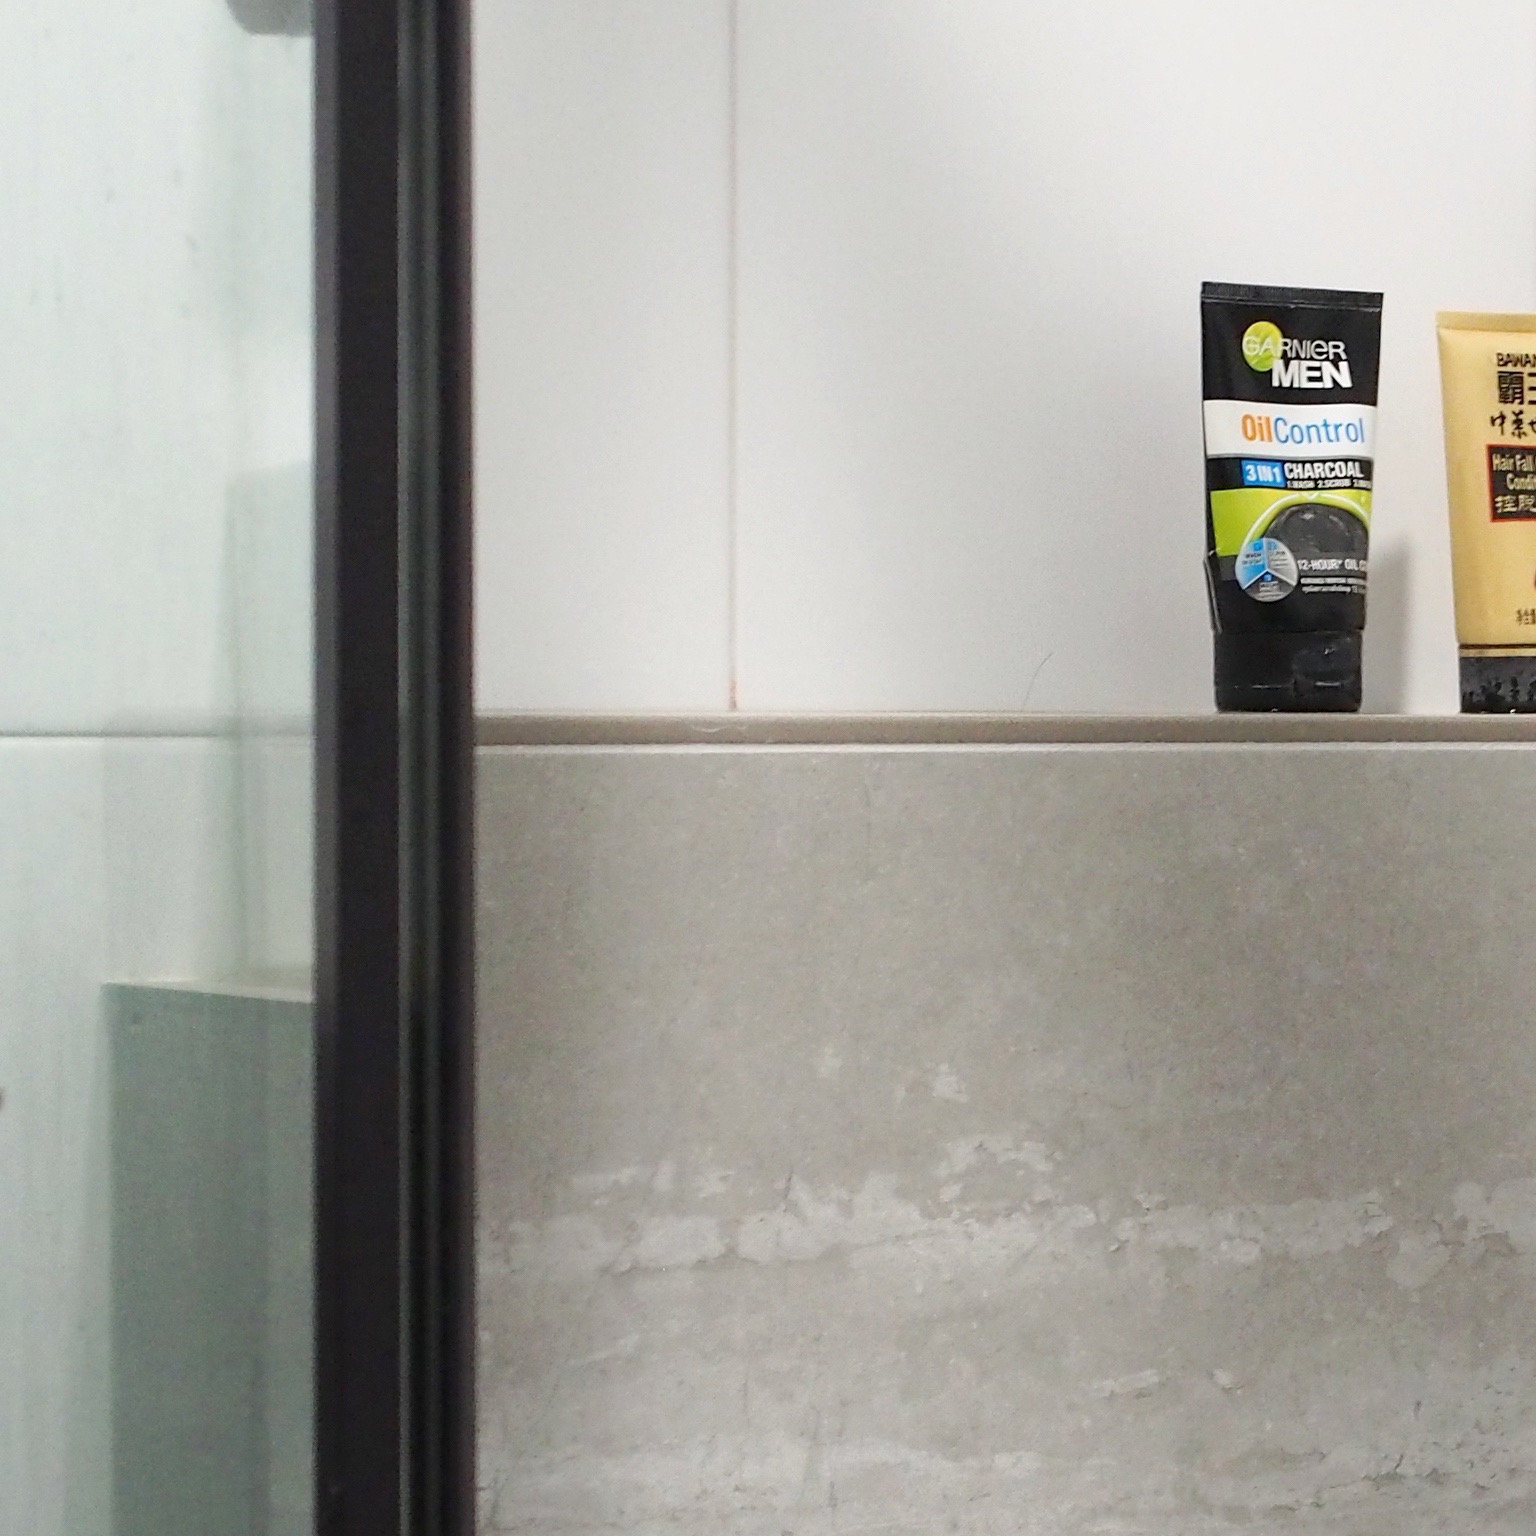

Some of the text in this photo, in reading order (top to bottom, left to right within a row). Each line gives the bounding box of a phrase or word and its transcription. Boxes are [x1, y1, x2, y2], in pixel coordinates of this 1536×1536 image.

[1243, 336, 1347, 360] GARNIER
[1272, 359, 1353, 389] MEN
[1284, 462, 1364, 479] CHARCOAL
[1492, 454, 1514, 472] Hair
[1515, 454, 1534, 472] Fall
